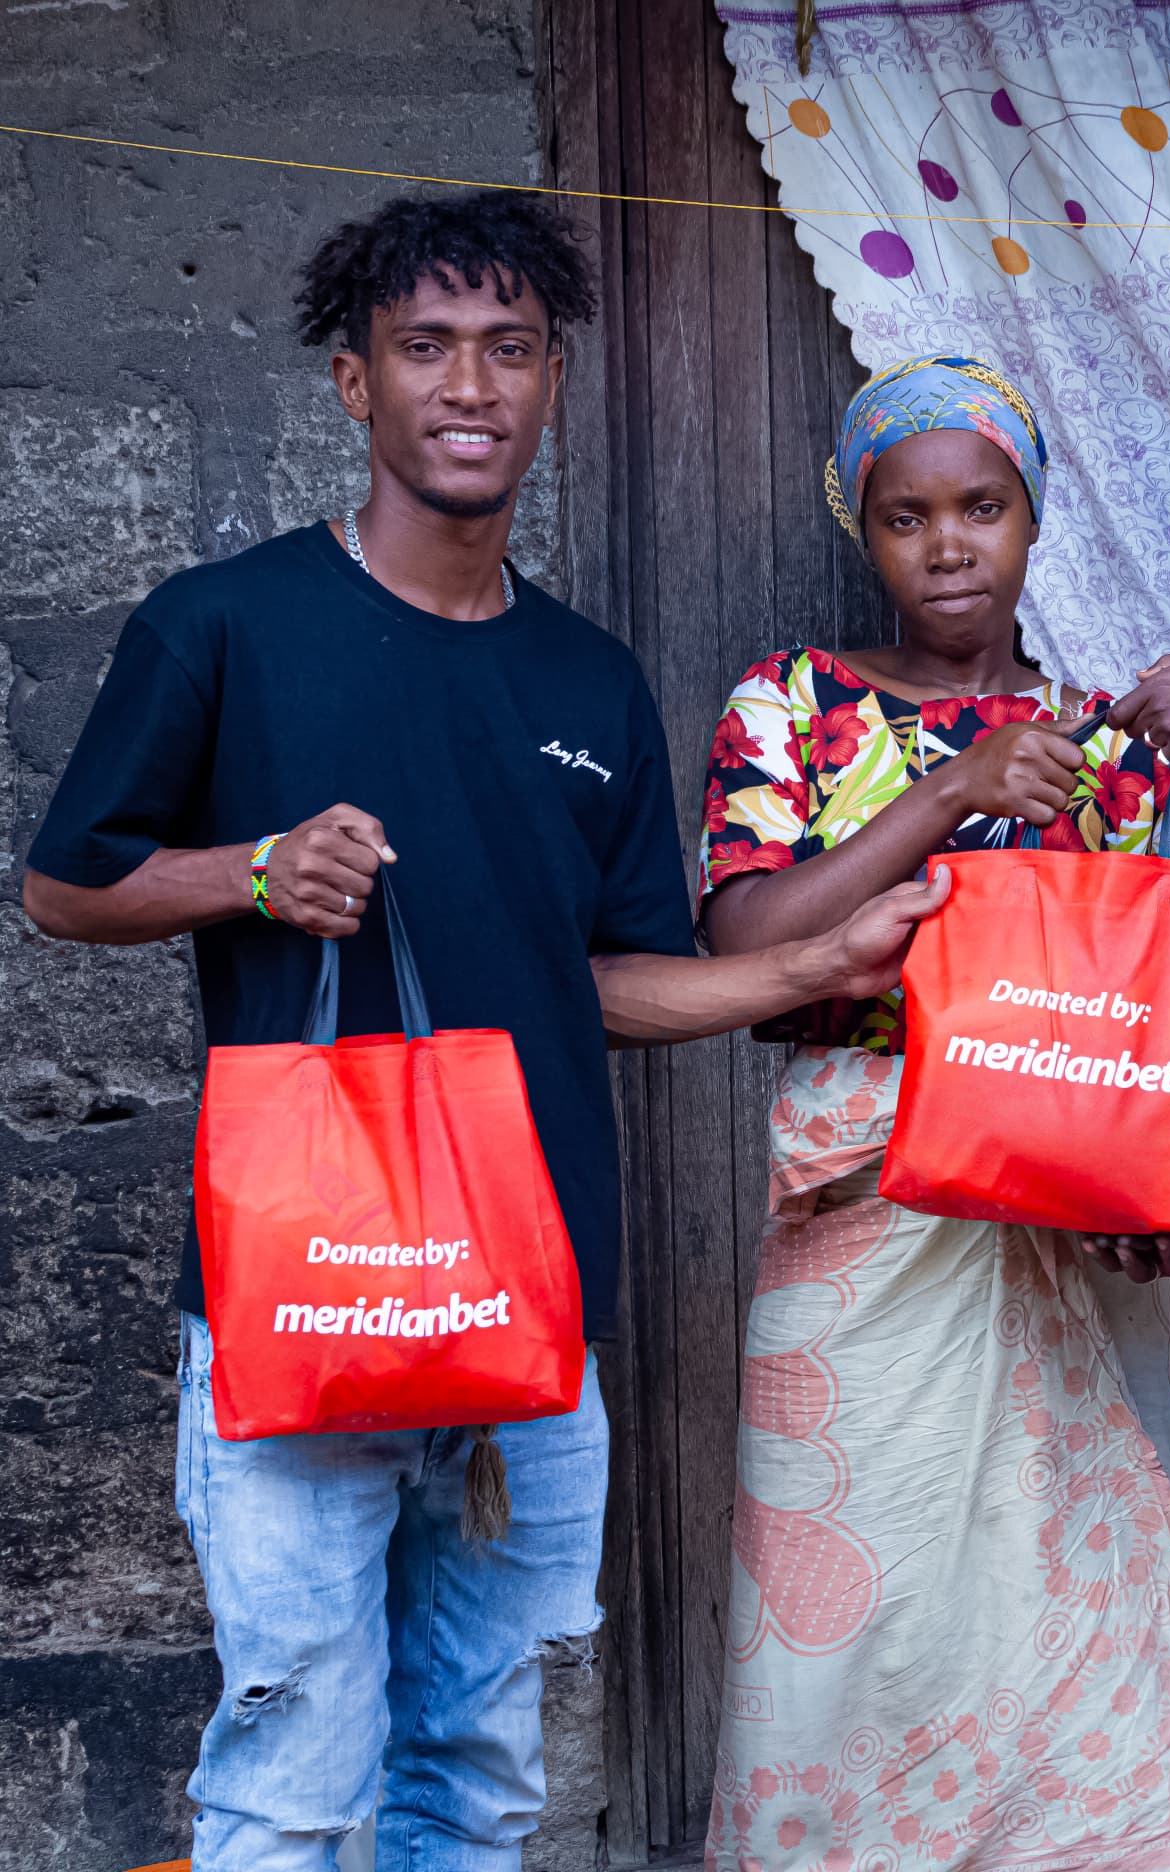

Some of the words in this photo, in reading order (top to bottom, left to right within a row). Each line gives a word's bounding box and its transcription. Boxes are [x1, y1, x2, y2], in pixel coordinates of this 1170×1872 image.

[988, 979, 1108, 1018] Donated
[1110, 992, 1152, 1028] by:
[424, 1237, 470, 1271] by:
[273, 1289, 511, 1339] meridianbet
